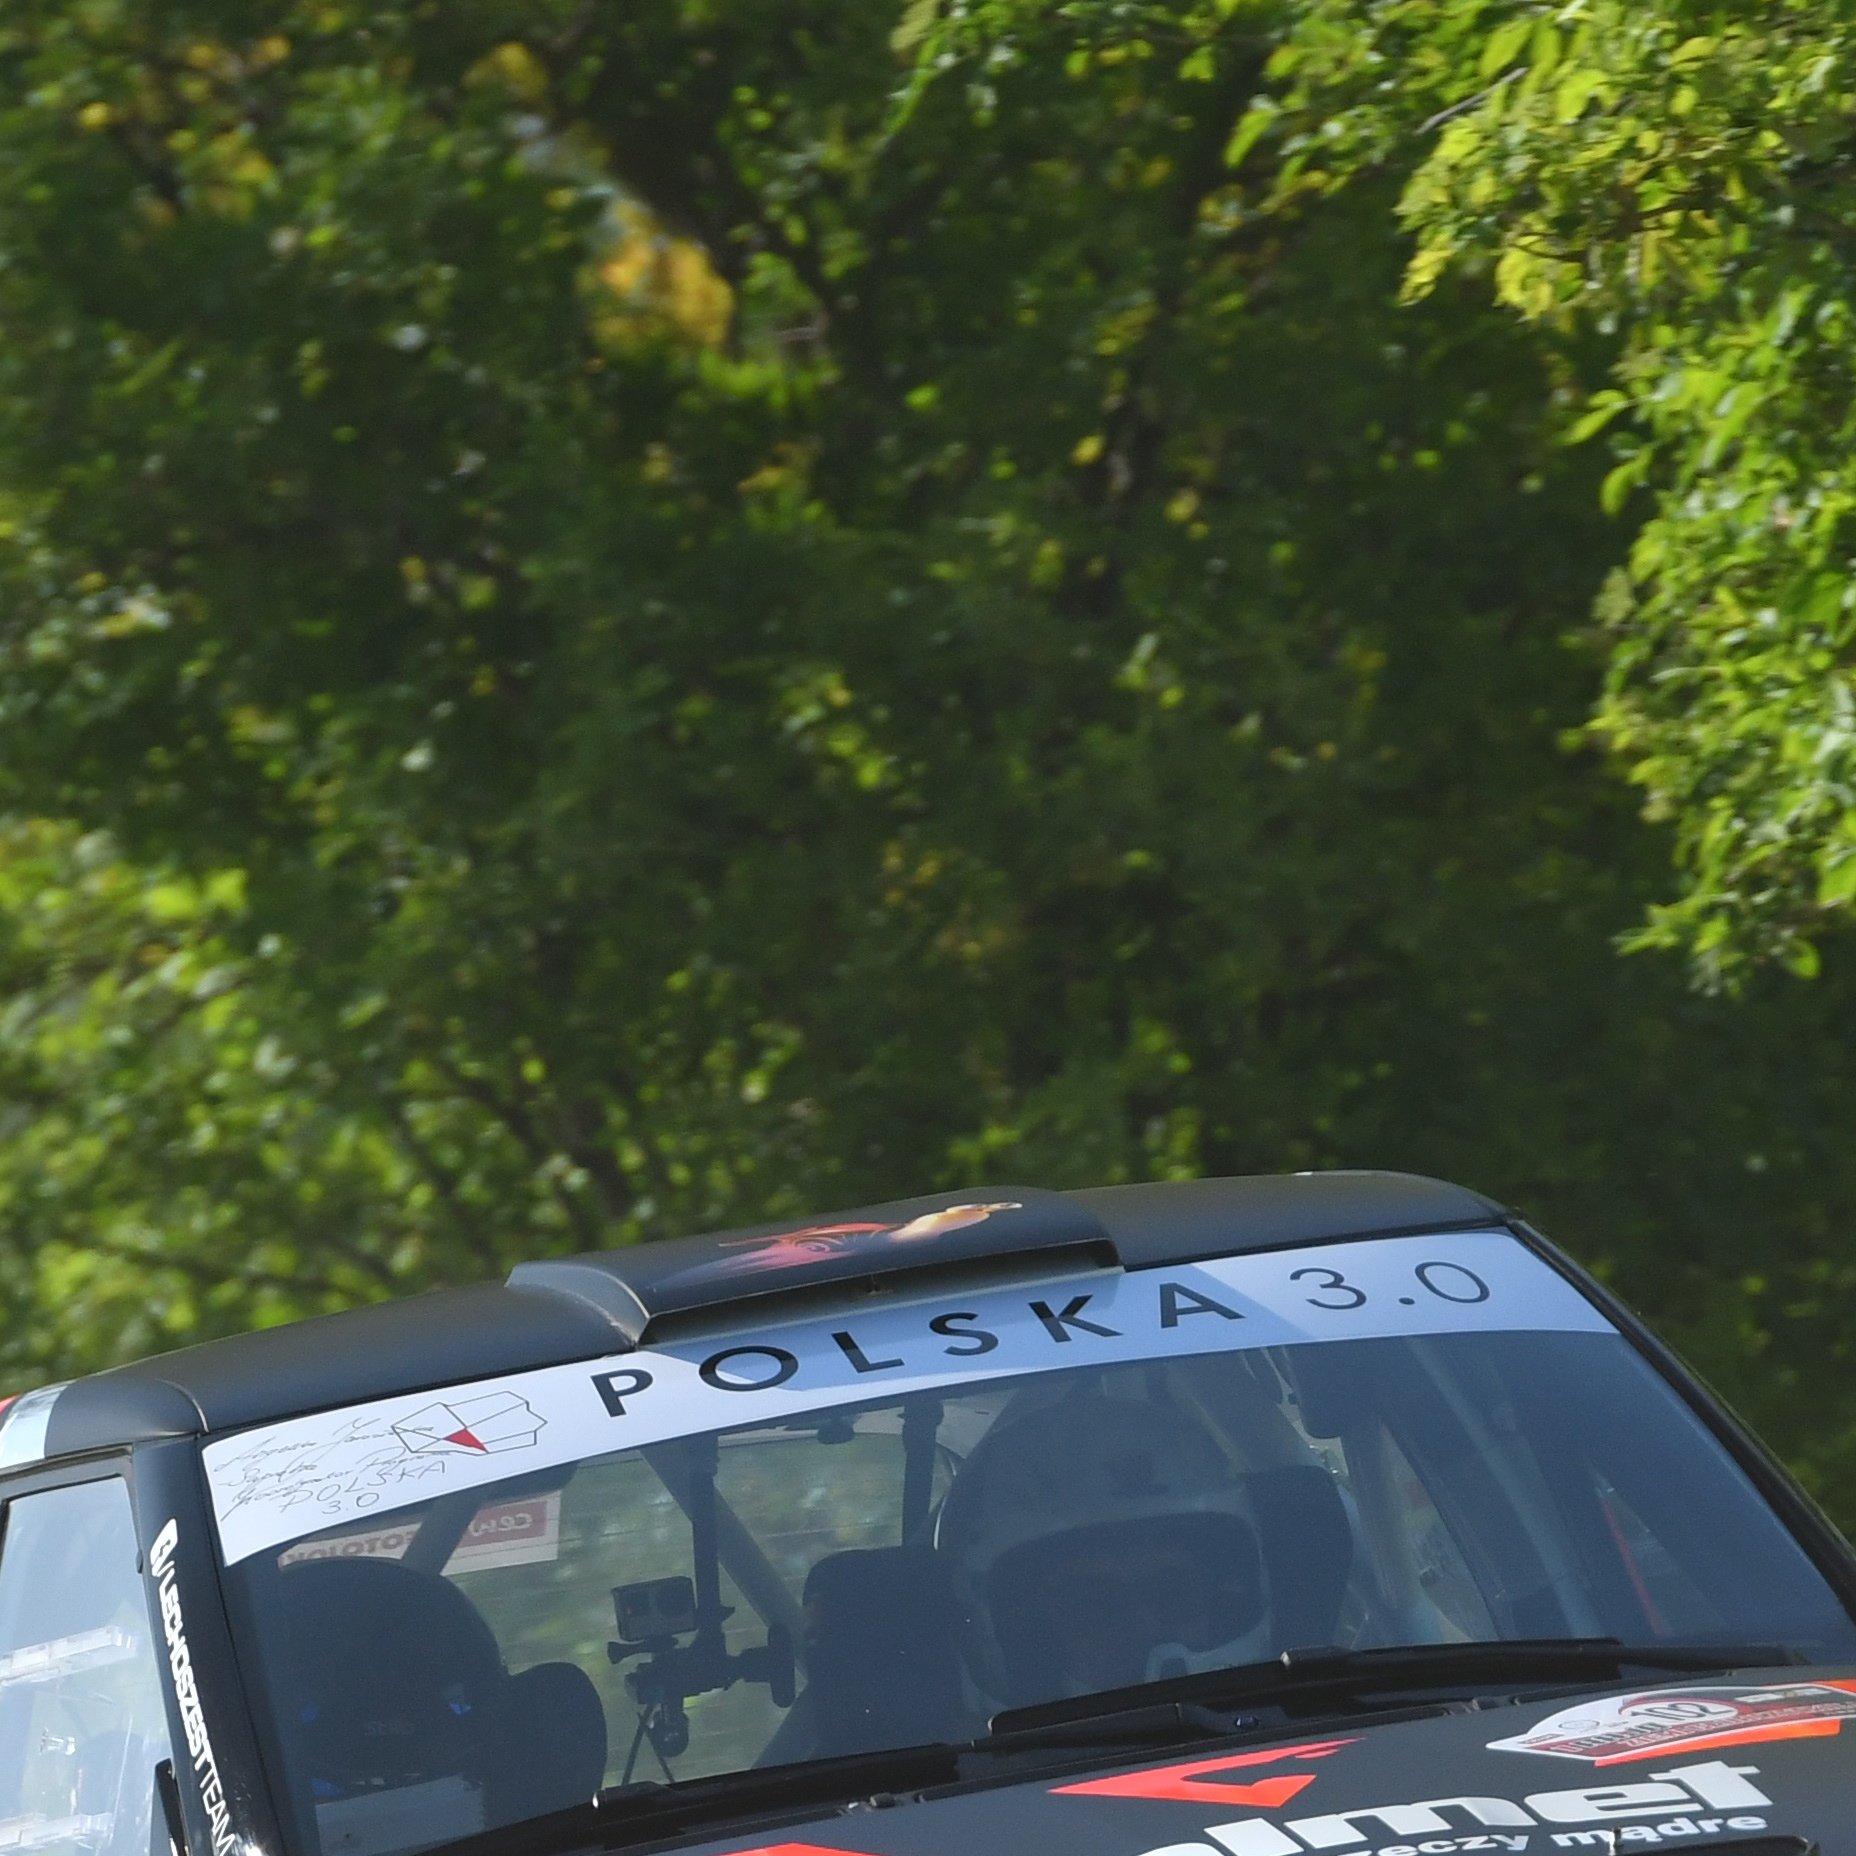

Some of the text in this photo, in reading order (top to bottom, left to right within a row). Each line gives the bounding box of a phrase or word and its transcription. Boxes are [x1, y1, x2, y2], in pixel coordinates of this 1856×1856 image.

[589, 1259, 1492, 1419] POLSKA 3.0
[279, 1459, 447, 1513] POLSKA
[1636, 1701, 1727, 1725] 102
[1553, 1810, 1769, 1851] mądre
